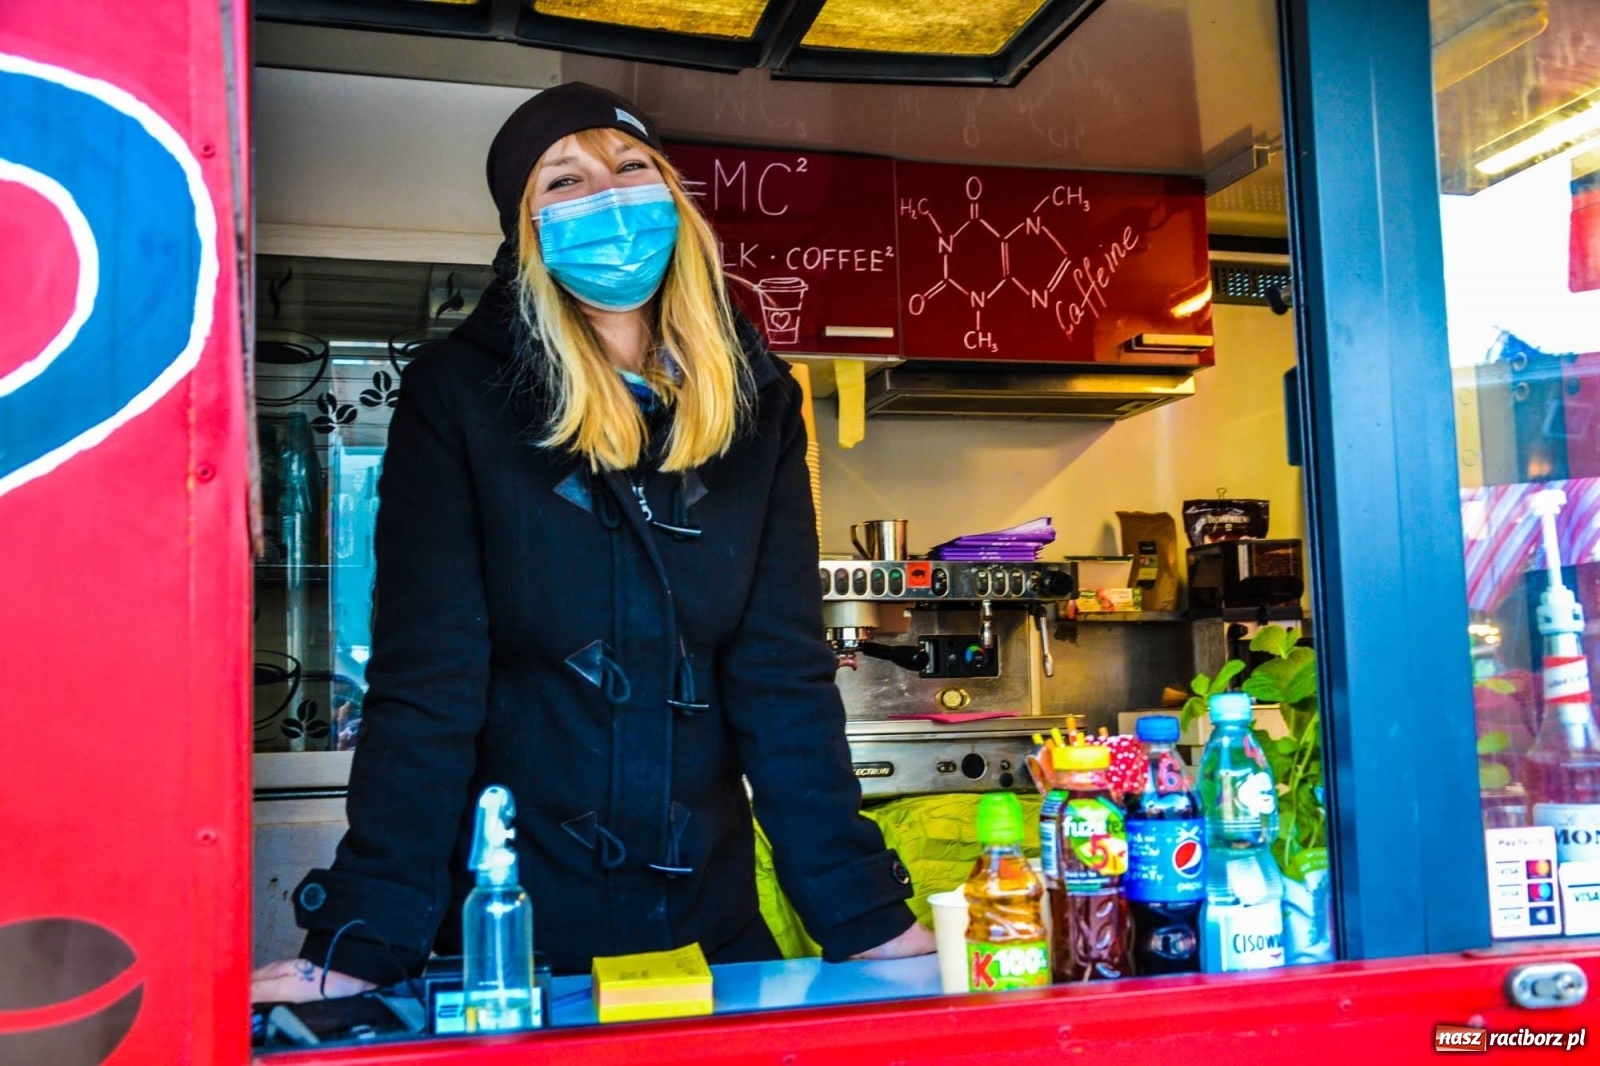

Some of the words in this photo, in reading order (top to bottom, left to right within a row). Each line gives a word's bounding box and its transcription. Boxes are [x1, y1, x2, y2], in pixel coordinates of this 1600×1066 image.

[1026, 216, 1041, 235] N
[938, 235, 953, 253] N
[1055, 226, 1140, 336] Caffeine
[971, 291, 985, 308] N
[1032, 289, 1048, 308] N
[1556, 829, 1600, 845] MO
